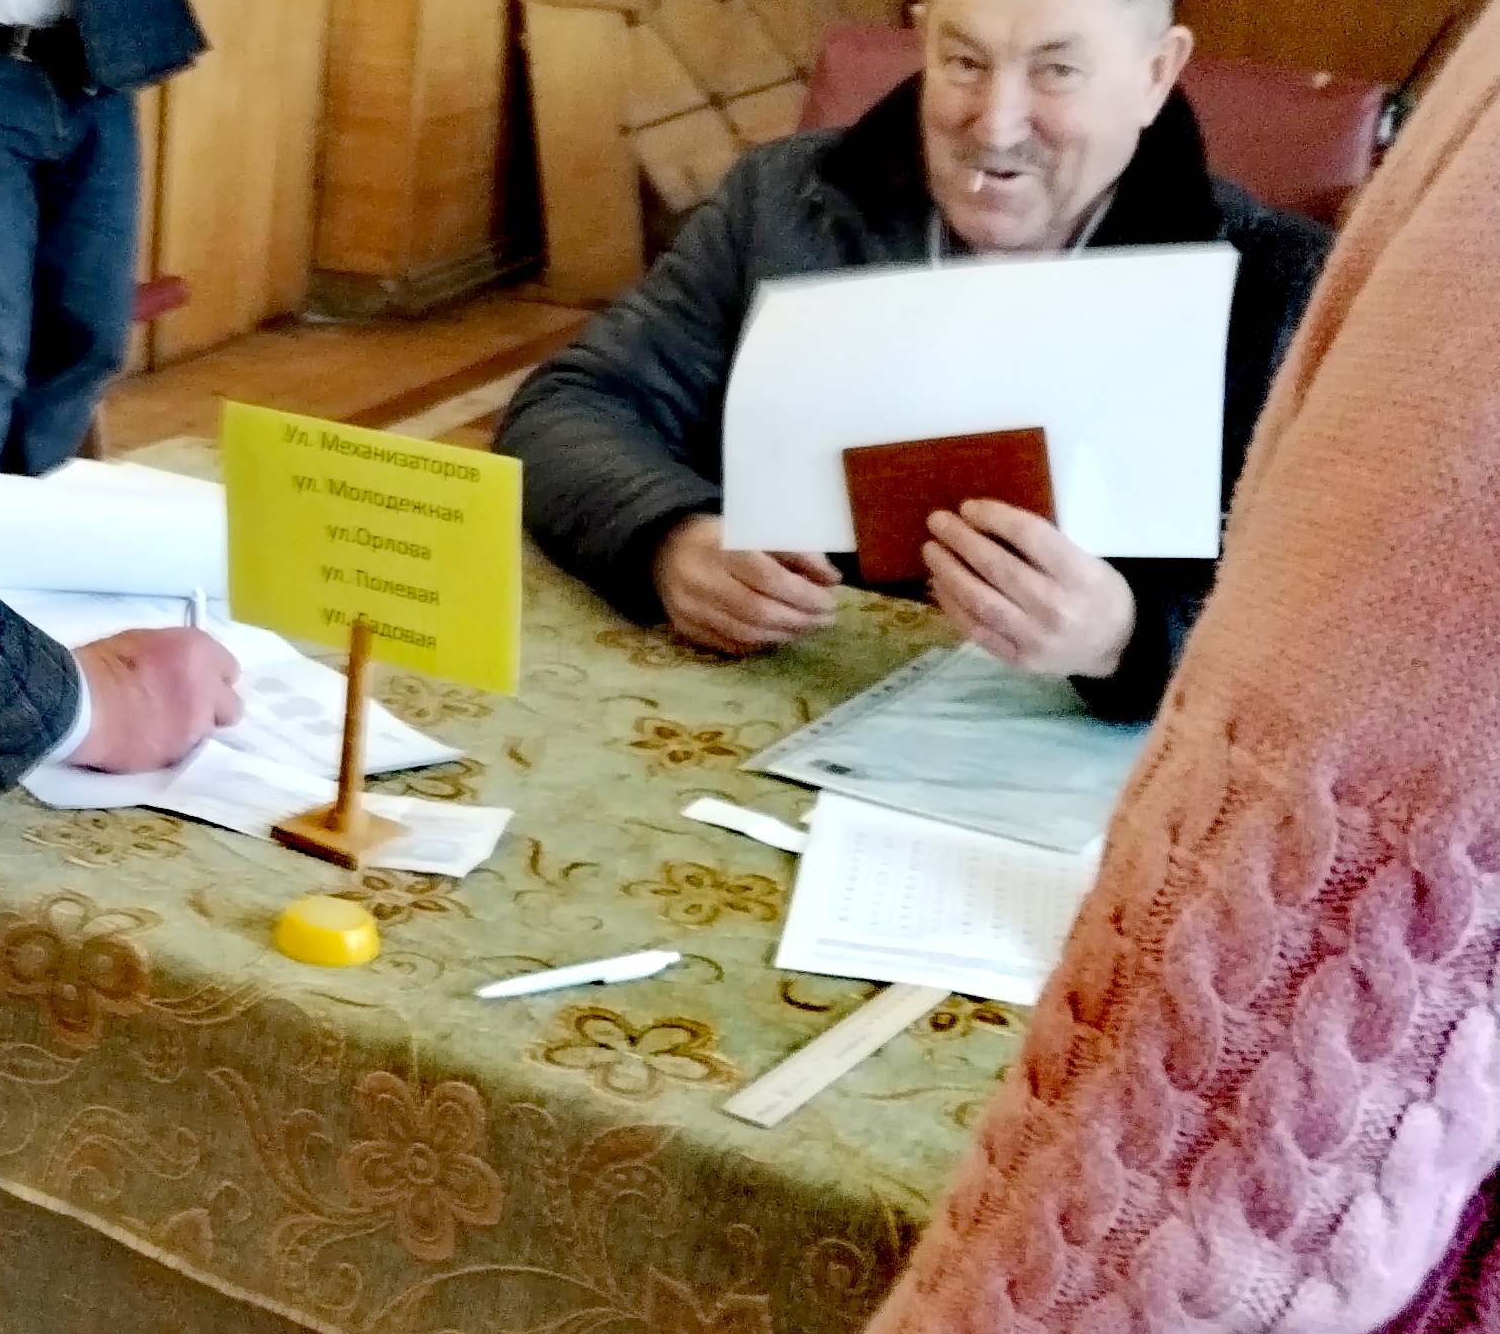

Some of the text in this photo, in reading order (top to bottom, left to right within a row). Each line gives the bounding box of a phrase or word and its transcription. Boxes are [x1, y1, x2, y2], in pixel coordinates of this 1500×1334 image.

[285, 424, 480, 482] Ул. Механизаторов
[292, 474, 320, 494] ул.
[320, 565, 439, 605] ул. Полевая
